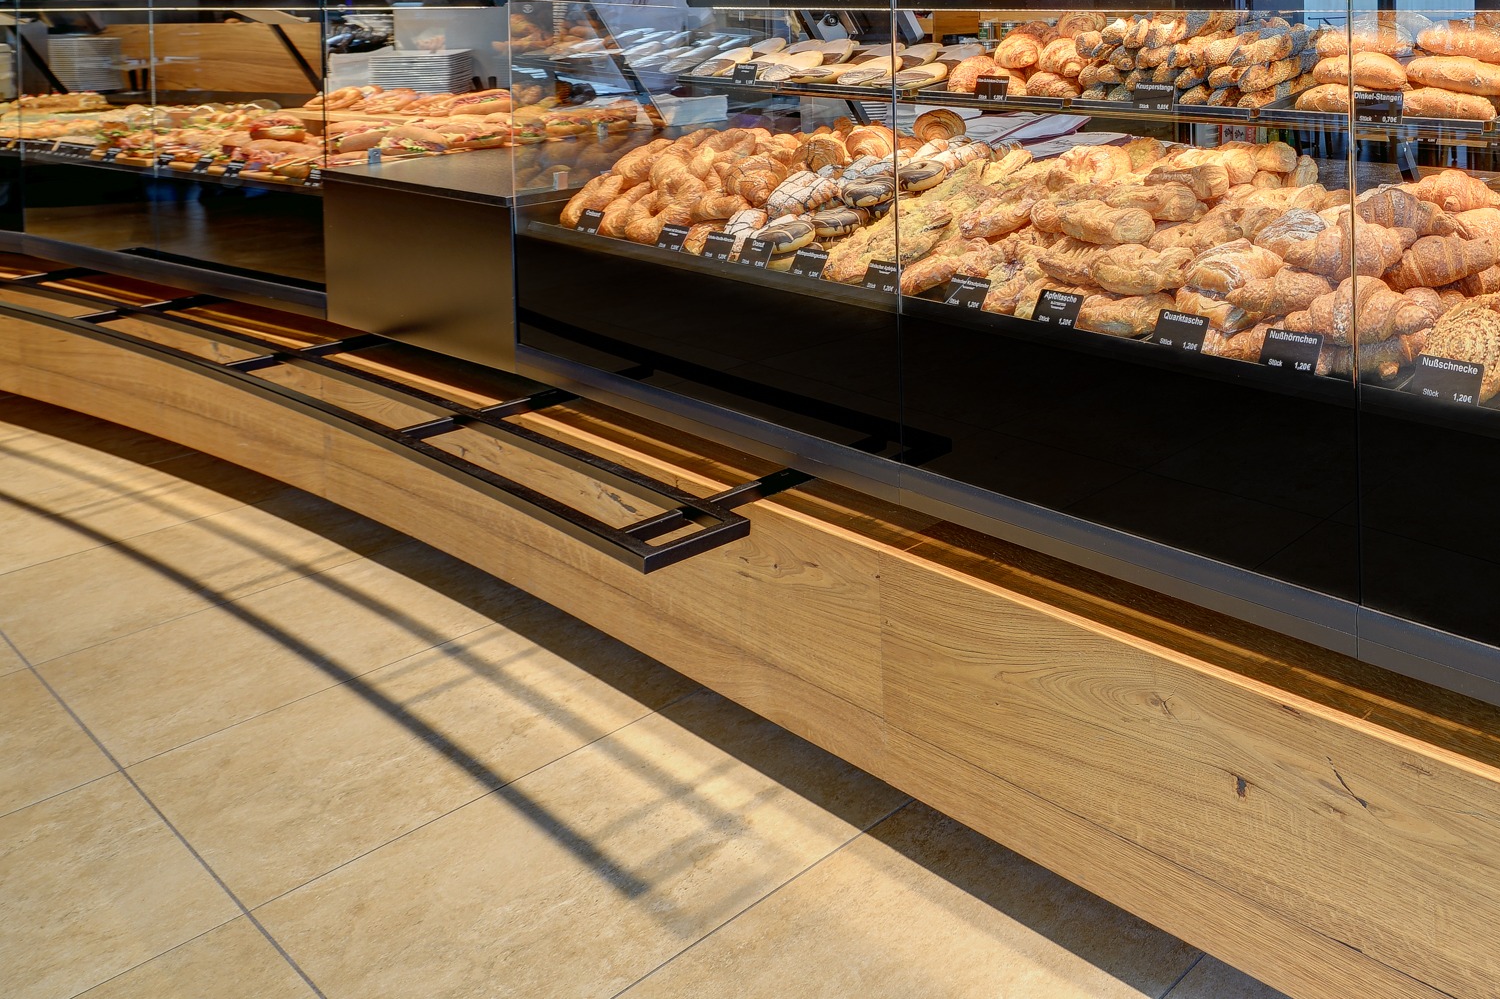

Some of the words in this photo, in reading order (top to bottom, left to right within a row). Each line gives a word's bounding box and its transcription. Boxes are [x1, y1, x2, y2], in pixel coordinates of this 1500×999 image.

[1136, 83, 1174, 92] Knusperstange
[1044, 290, 1078, 304] Apfeltasche
[1038, 314, 1051, 322] Stück
[1058, 317, 1073, 326] 1,20€
[1163, 311, 1204, 326] Quarktasche
[1159, 337, 1173, 346] Stück
[1182, 341, 1198, 351] 1,20€
[1269, 329, 1318, 345] Nußhörnchen
[1268, 358, 1283, 367] Stück
[1294, 361, 1311, 371] 1,20€
[1422, 356, 1479, 375] Nußschnecke
[1422, 388, 1439, 398] Stück
[1453, 393, 1473, 404] 1,20€
